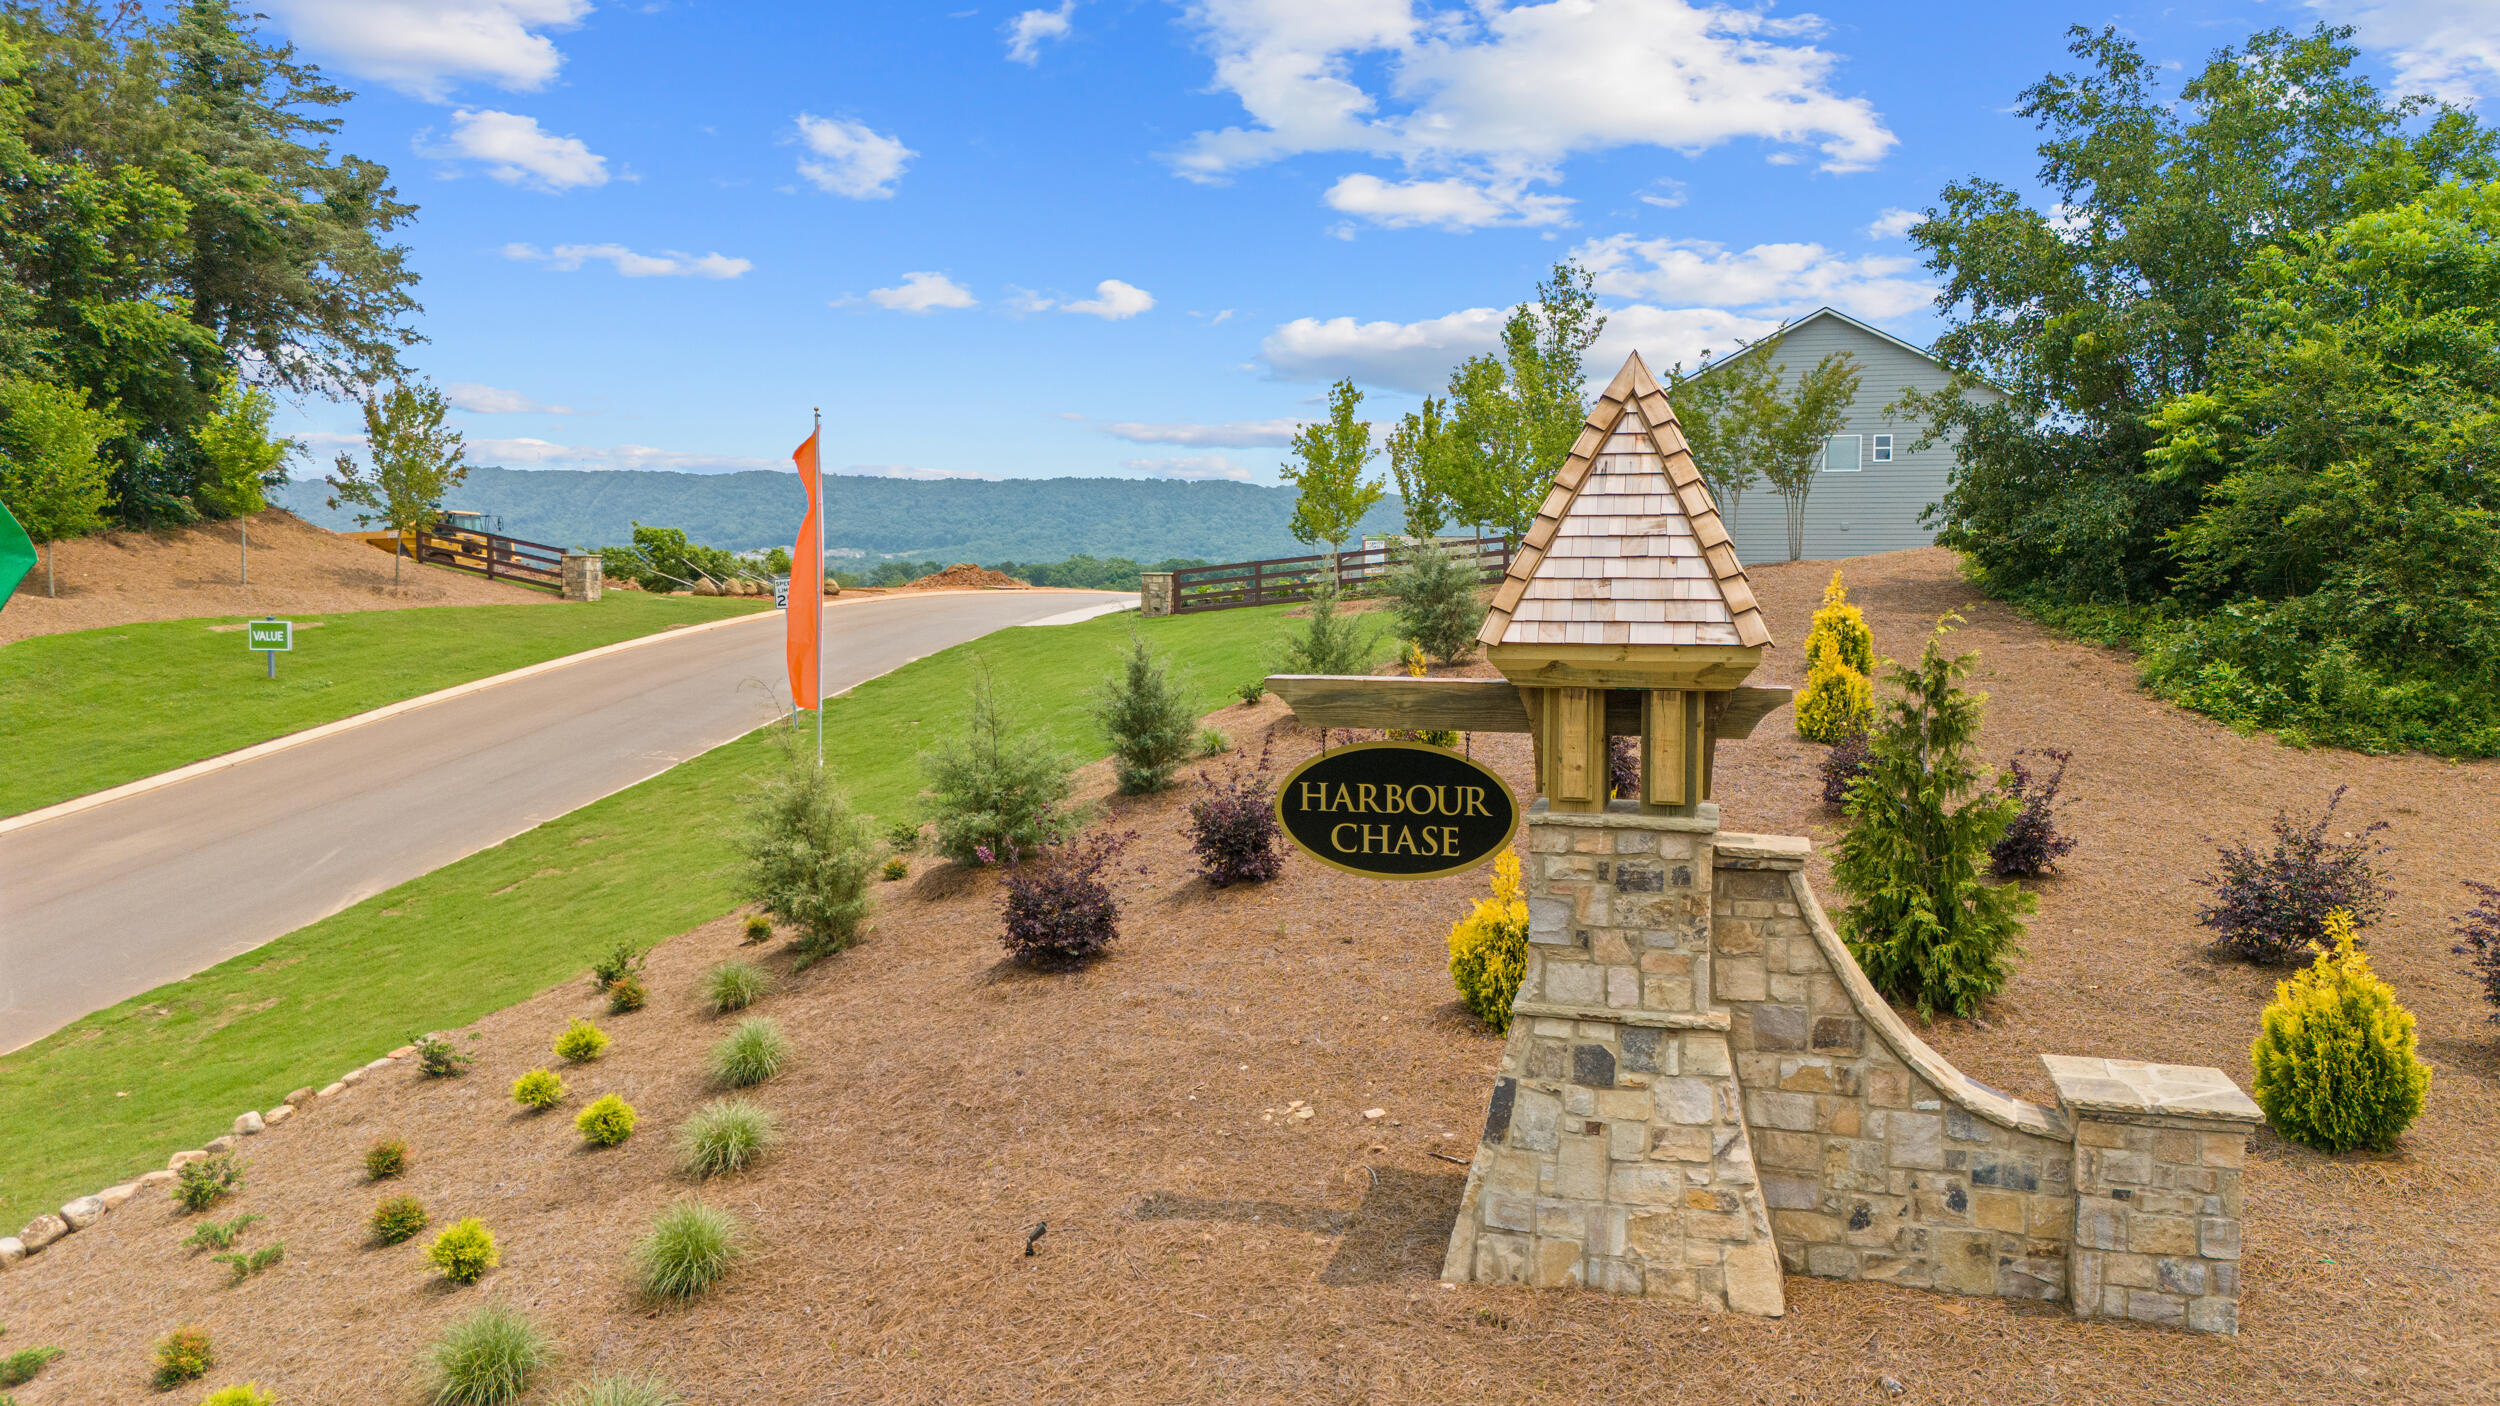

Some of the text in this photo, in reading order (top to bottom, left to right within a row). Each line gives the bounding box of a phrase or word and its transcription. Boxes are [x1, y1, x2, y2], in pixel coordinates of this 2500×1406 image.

[777, 594, 787, 606] 2
[252, 630, 285, 642] VALUE
[1299, 781, 1493, 817] HARBOUR
[1331, 822, 1460, 857] CHASE
